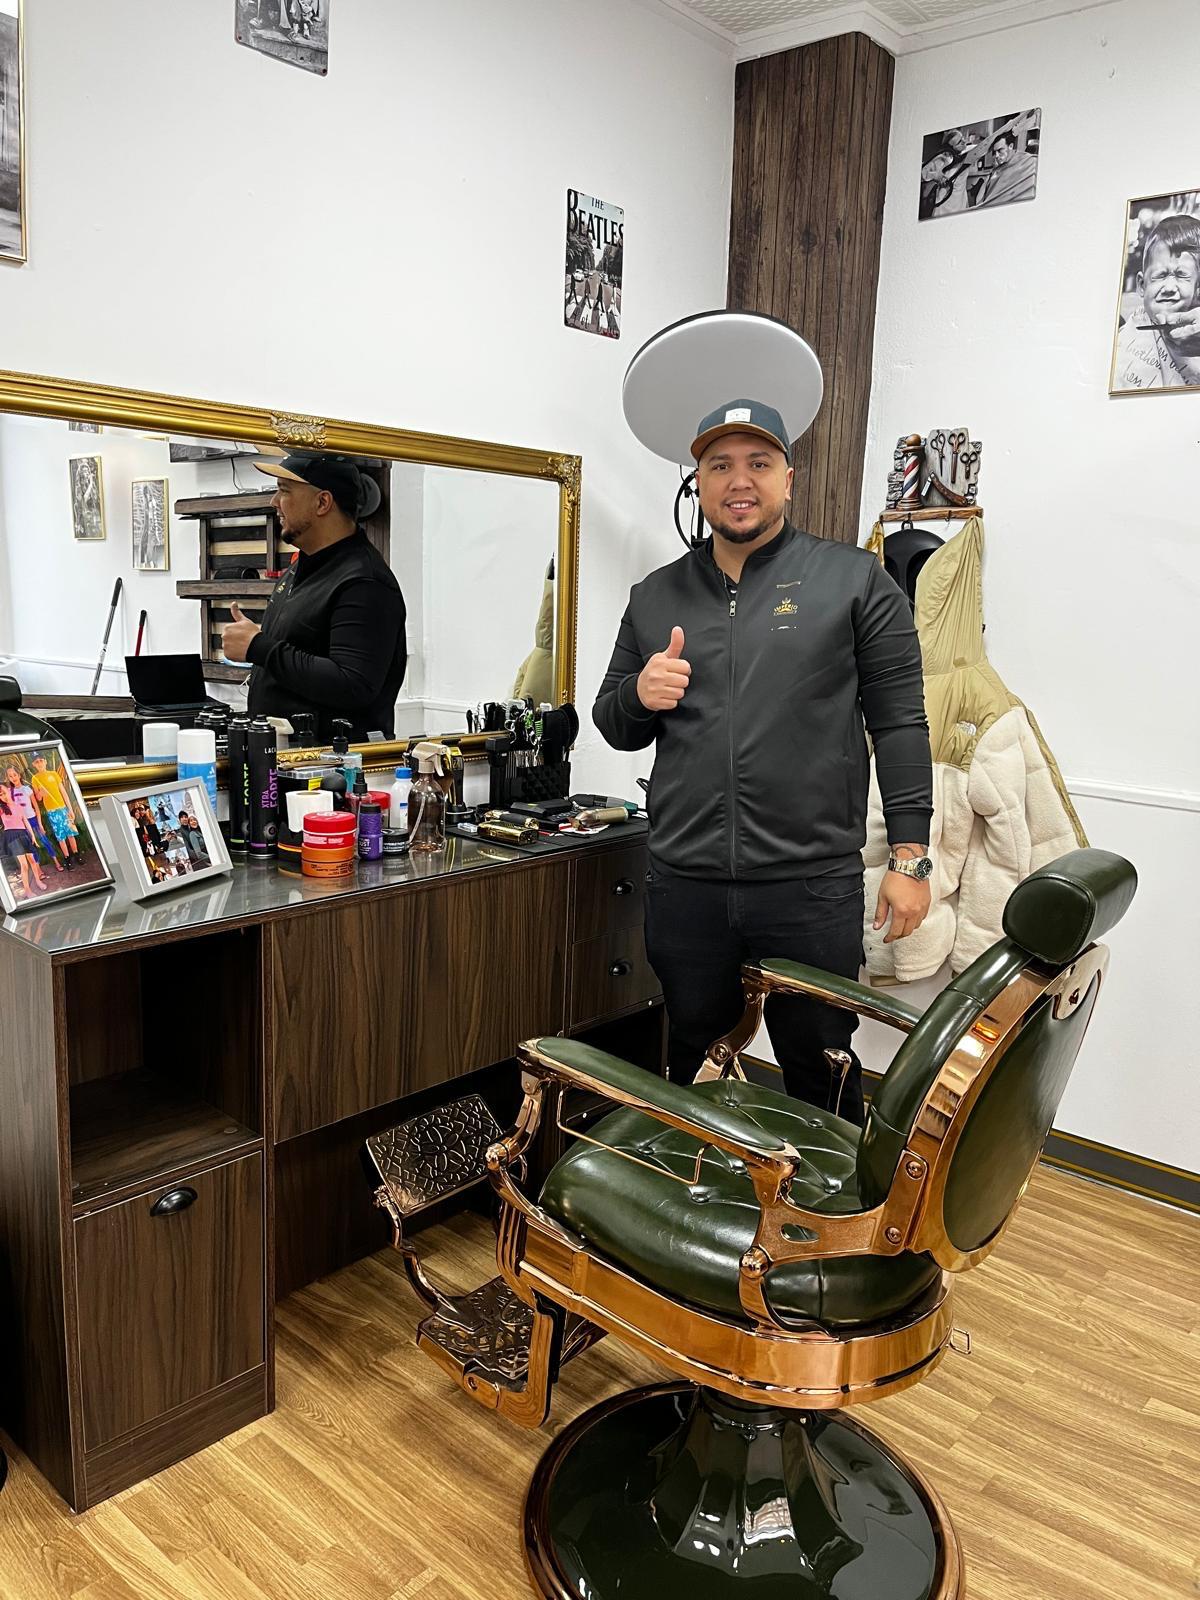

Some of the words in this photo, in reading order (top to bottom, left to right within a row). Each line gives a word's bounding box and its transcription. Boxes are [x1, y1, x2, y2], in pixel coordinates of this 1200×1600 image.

[591, 197, 605, 211] THE
[567, 189, 624, 250] BEATLES
[261, 789, 269, 809] XTRA
[269, 768, 279, 809] FORTE
